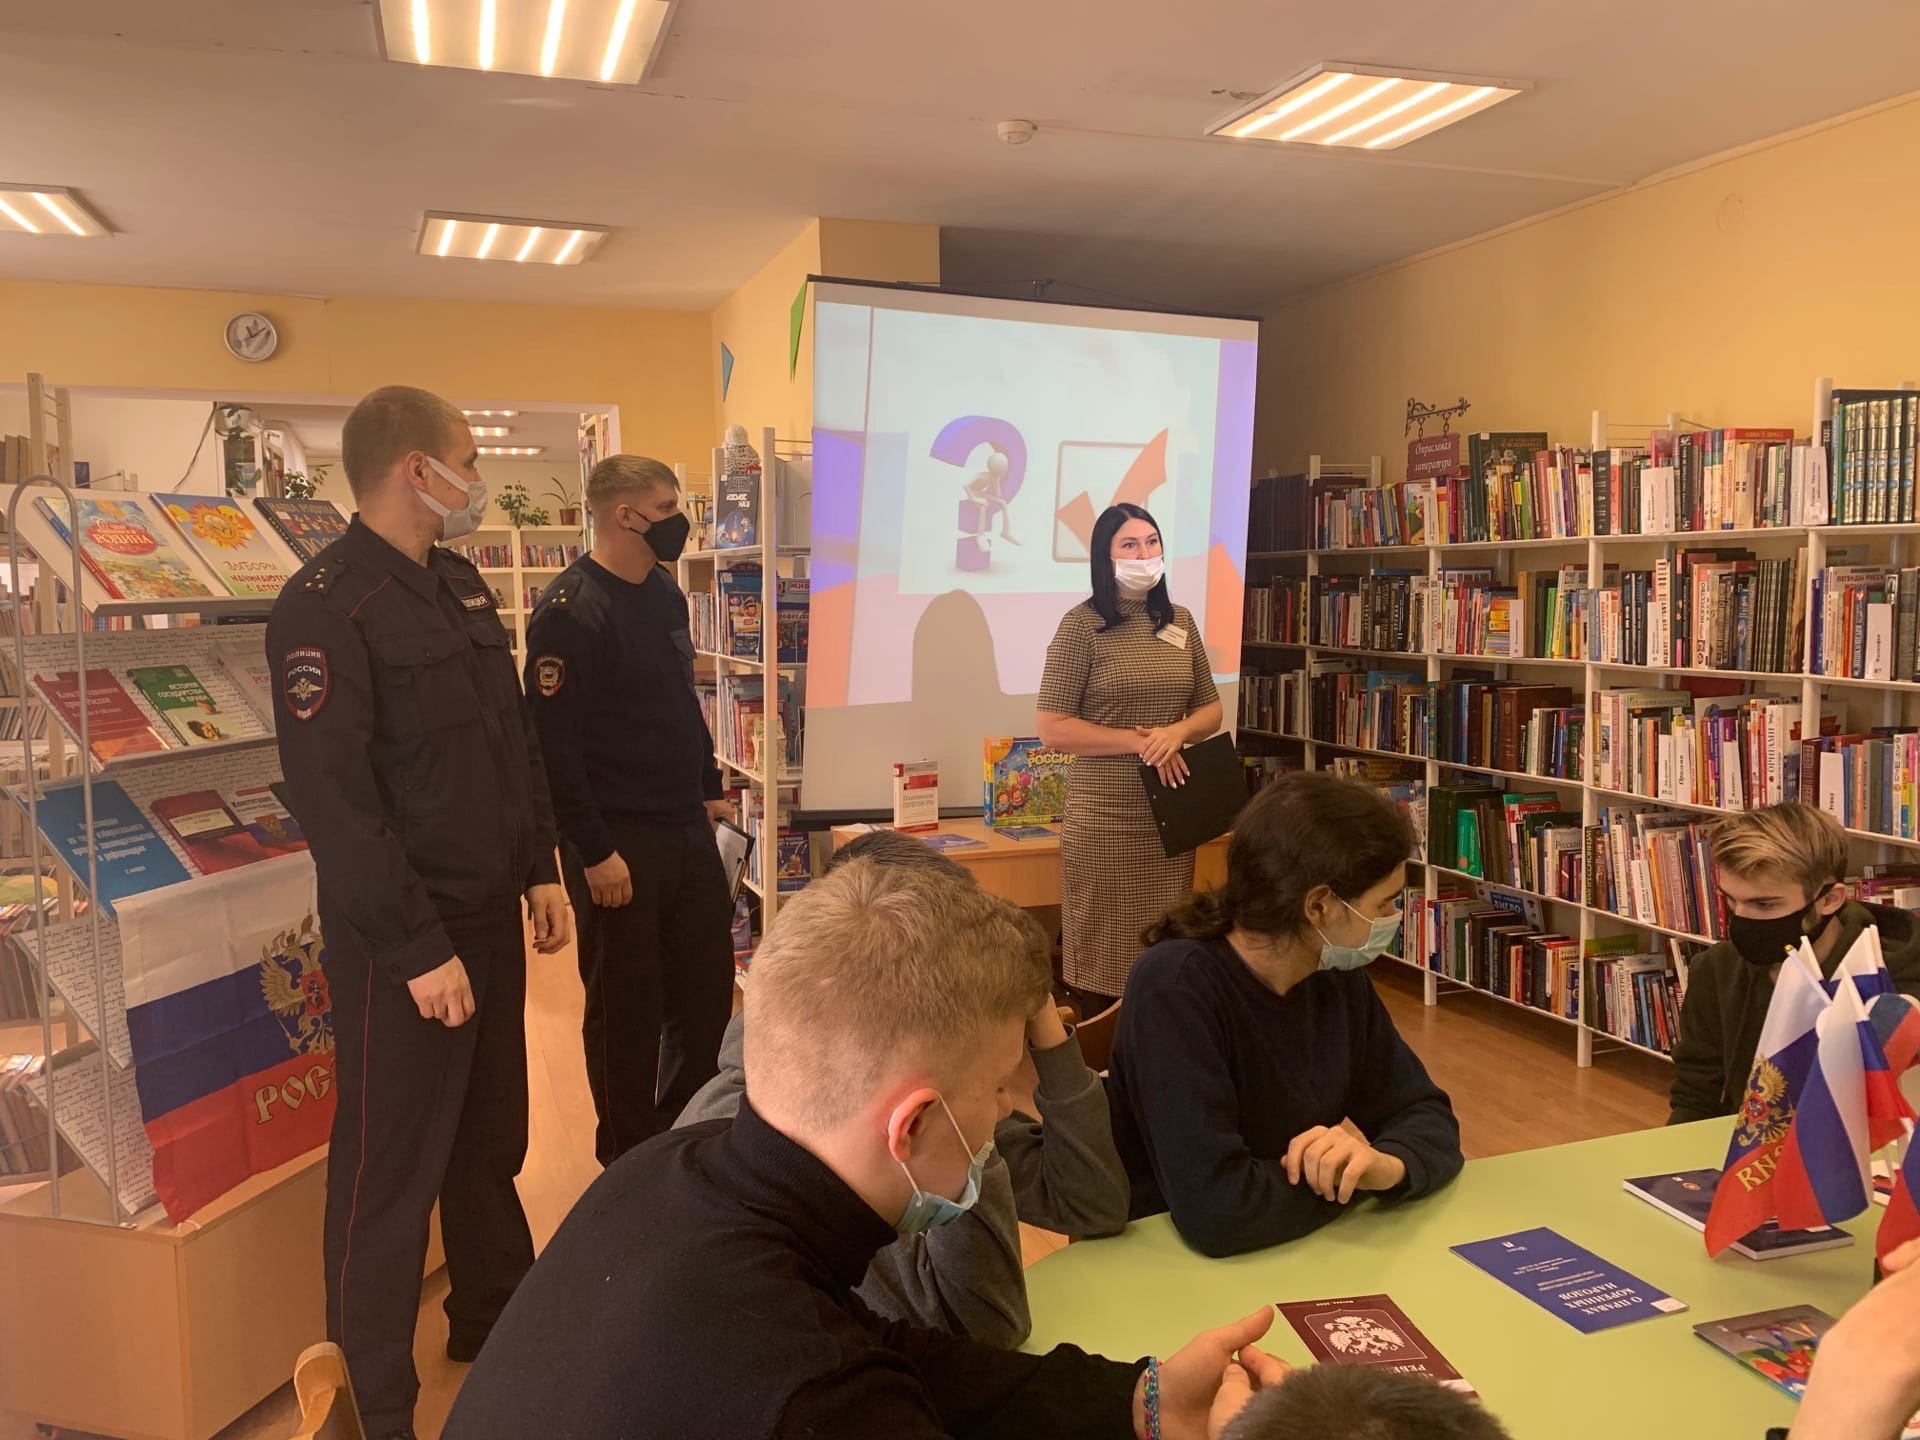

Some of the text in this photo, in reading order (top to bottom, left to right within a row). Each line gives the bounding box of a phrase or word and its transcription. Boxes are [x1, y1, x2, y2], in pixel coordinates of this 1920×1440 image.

[230, 574, 289, 584] НАЧИНАЮТС
[286, 650, 321, 661] ПОЛИЦИЯ
[287, 665, 321, 678] РОССИЯ
[254, 1060, 337, 1125] РОС
[1558, 1282, 1618, 1301] НАРОДОВ
[1564, 1287, 1636, 1309] КОРЕННЫХ
[1581, 1299, 1632, 1316] ПРАВАХ
[1388, 1364, 1426, 1374] РЕБЕ
